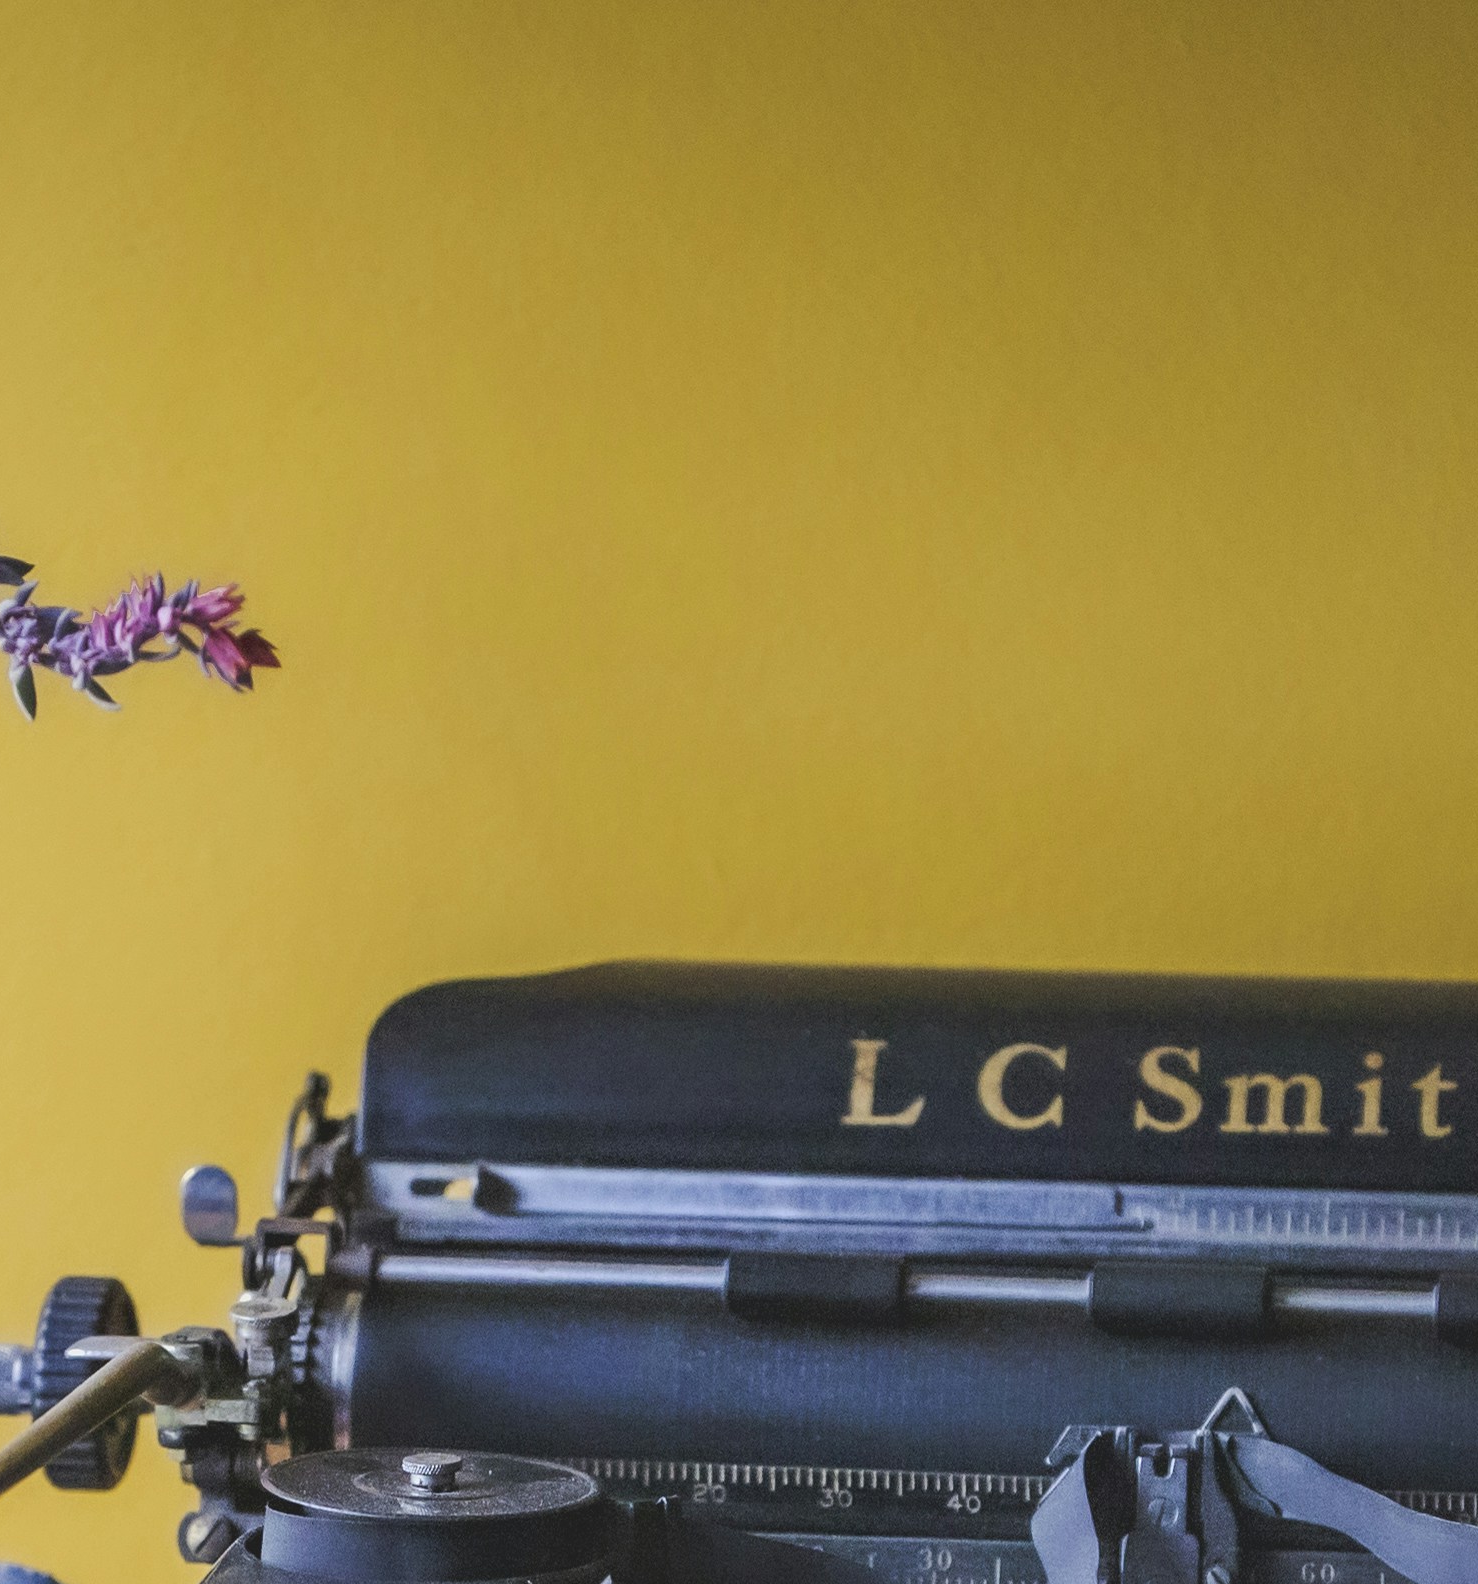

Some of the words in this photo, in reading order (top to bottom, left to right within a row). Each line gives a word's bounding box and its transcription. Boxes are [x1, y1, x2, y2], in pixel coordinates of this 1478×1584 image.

[841, 1038, 925, 1127] L
[977, 1042, 1068, 1130] C
[692, 1483, 727, 1504] 20
[820, 1488, 854, 1509] 30
[946, 1494, 982, 1515] 40
[918, 1547, 953, 1572] 30
[1300, 1561, 1337, 1584] 60
